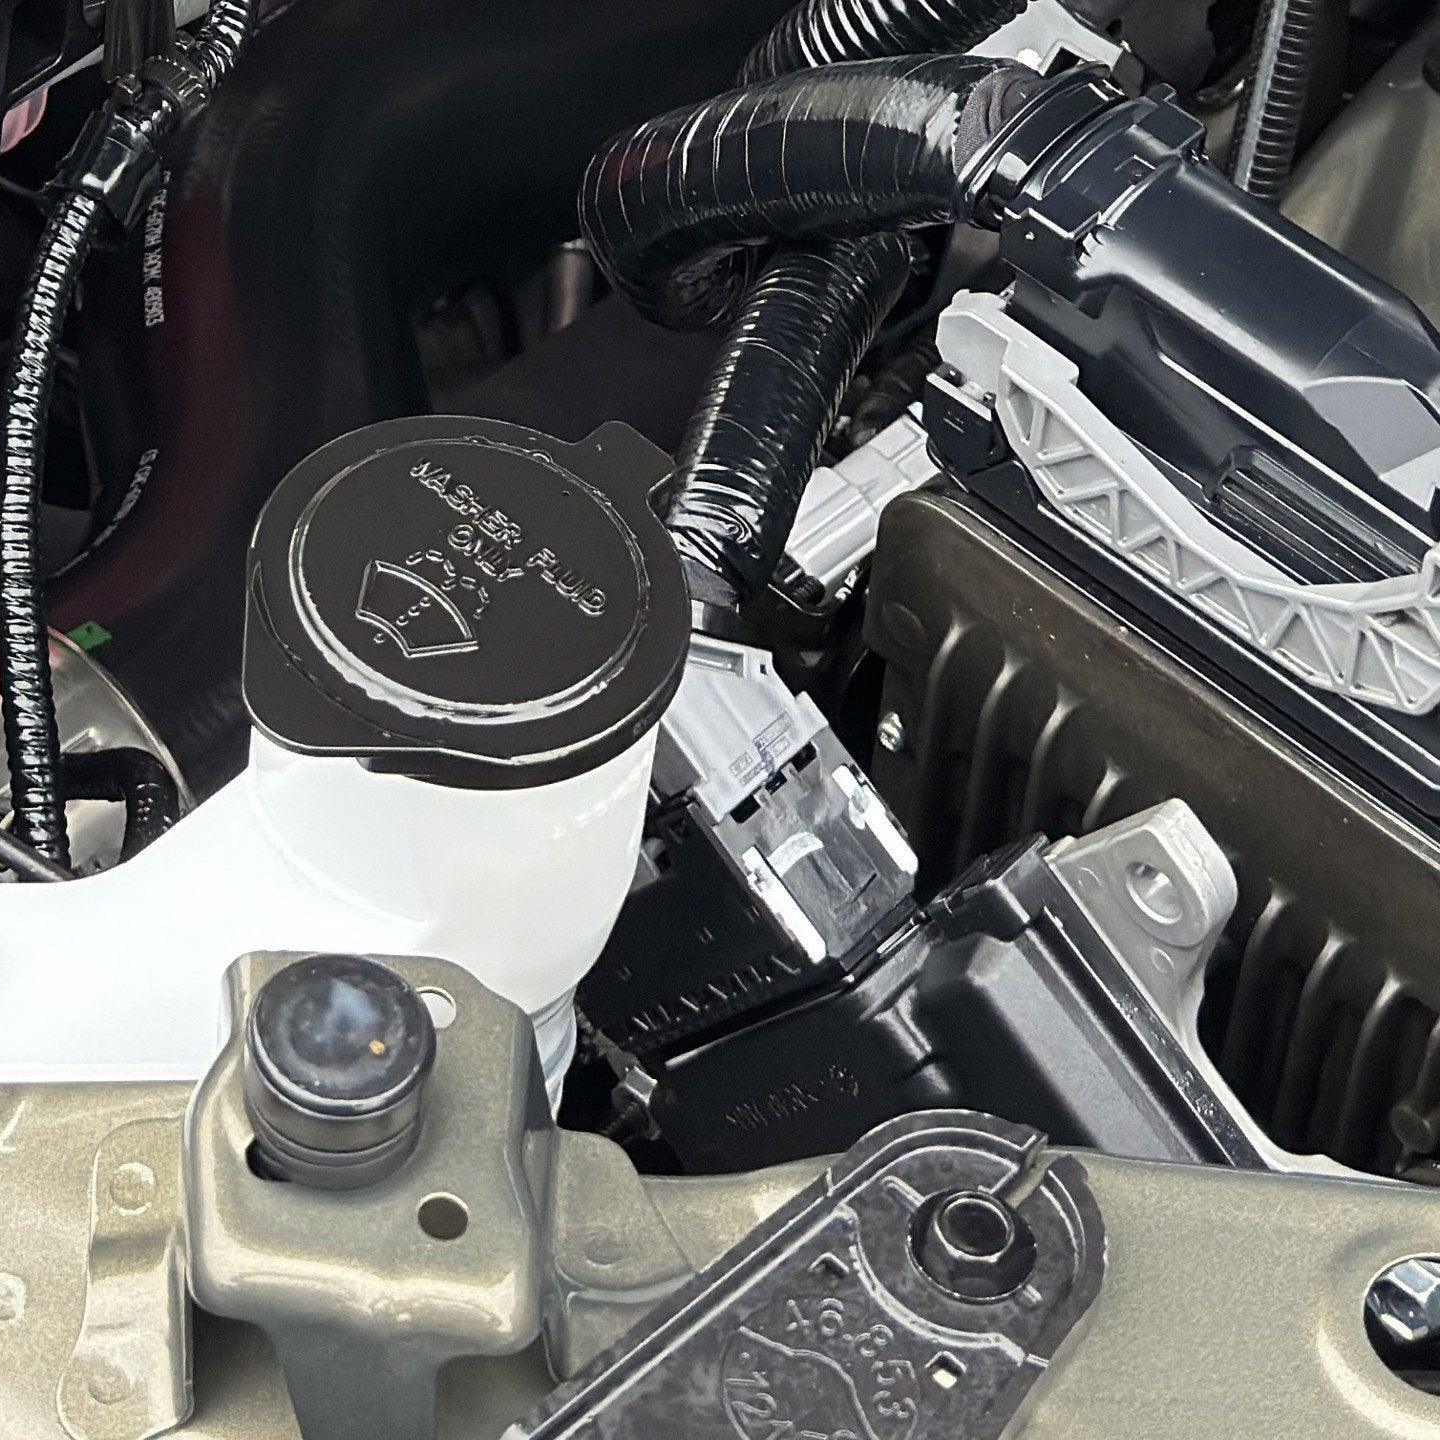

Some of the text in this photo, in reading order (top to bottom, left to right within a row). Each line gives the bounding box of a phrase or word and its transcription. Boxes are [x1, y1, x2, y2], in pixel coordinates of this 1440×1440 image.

[409, 457, 609, 618] WASHER FLUID
[447, 523, 524, 582] ONLY
